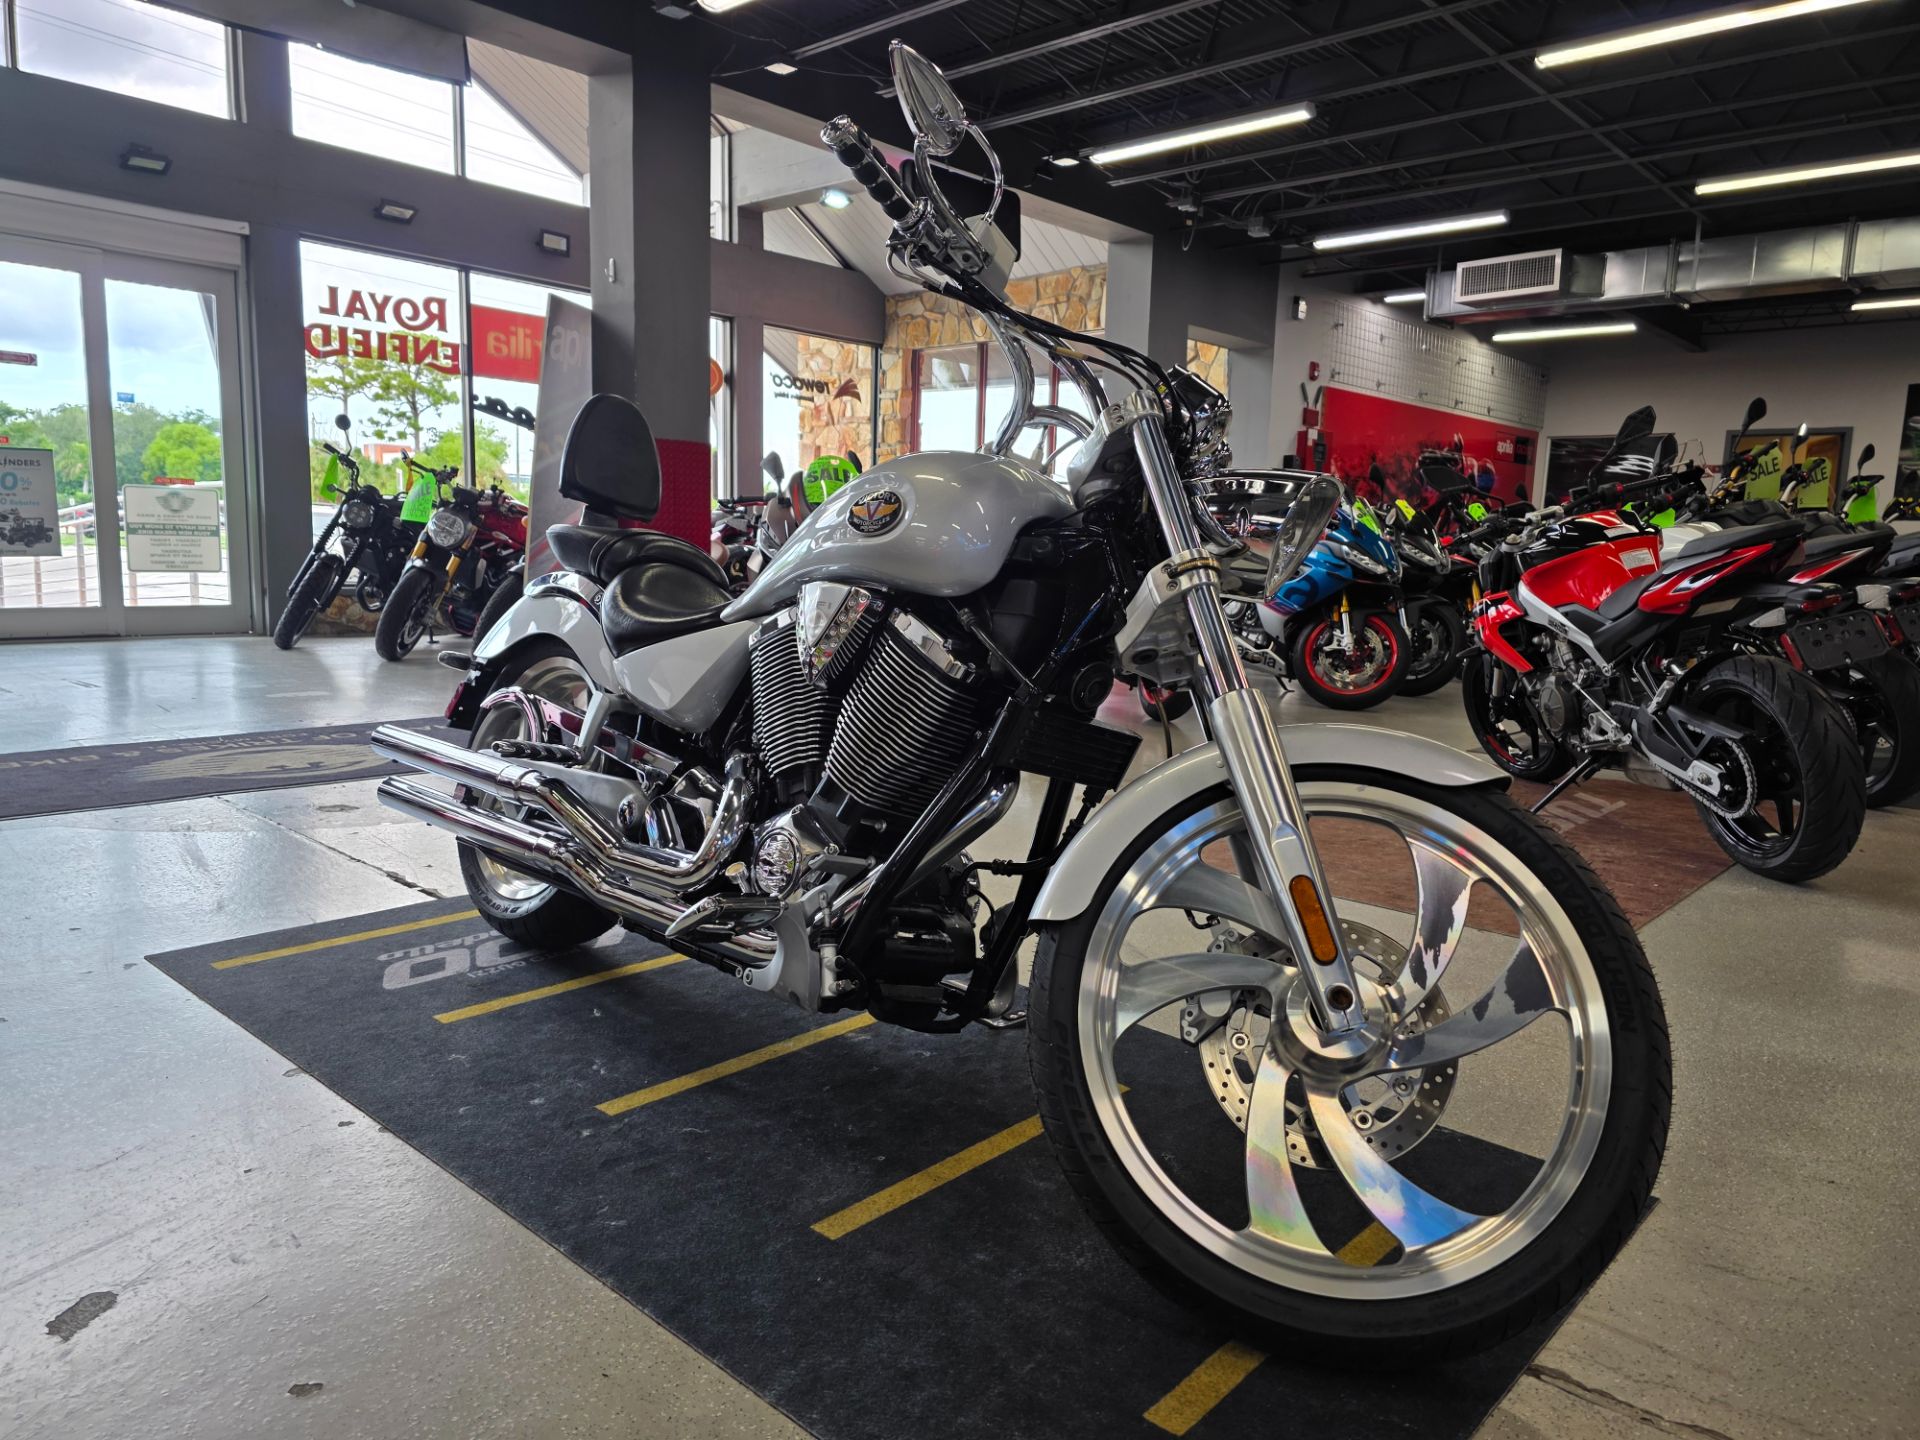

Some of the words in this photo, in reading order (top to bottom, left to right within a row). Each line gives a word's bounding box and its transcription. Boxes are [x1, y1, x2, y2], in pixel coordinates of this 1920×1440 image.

[1750, 456, 1781, 482] SALE
[0, 754, 99, 769] BIKE
[467, 960, 527, 978] GUZZI
[1599, 953, 1637, 1033] NIGHT
[1053, 1018, 1109, 1165] PIRELLI
